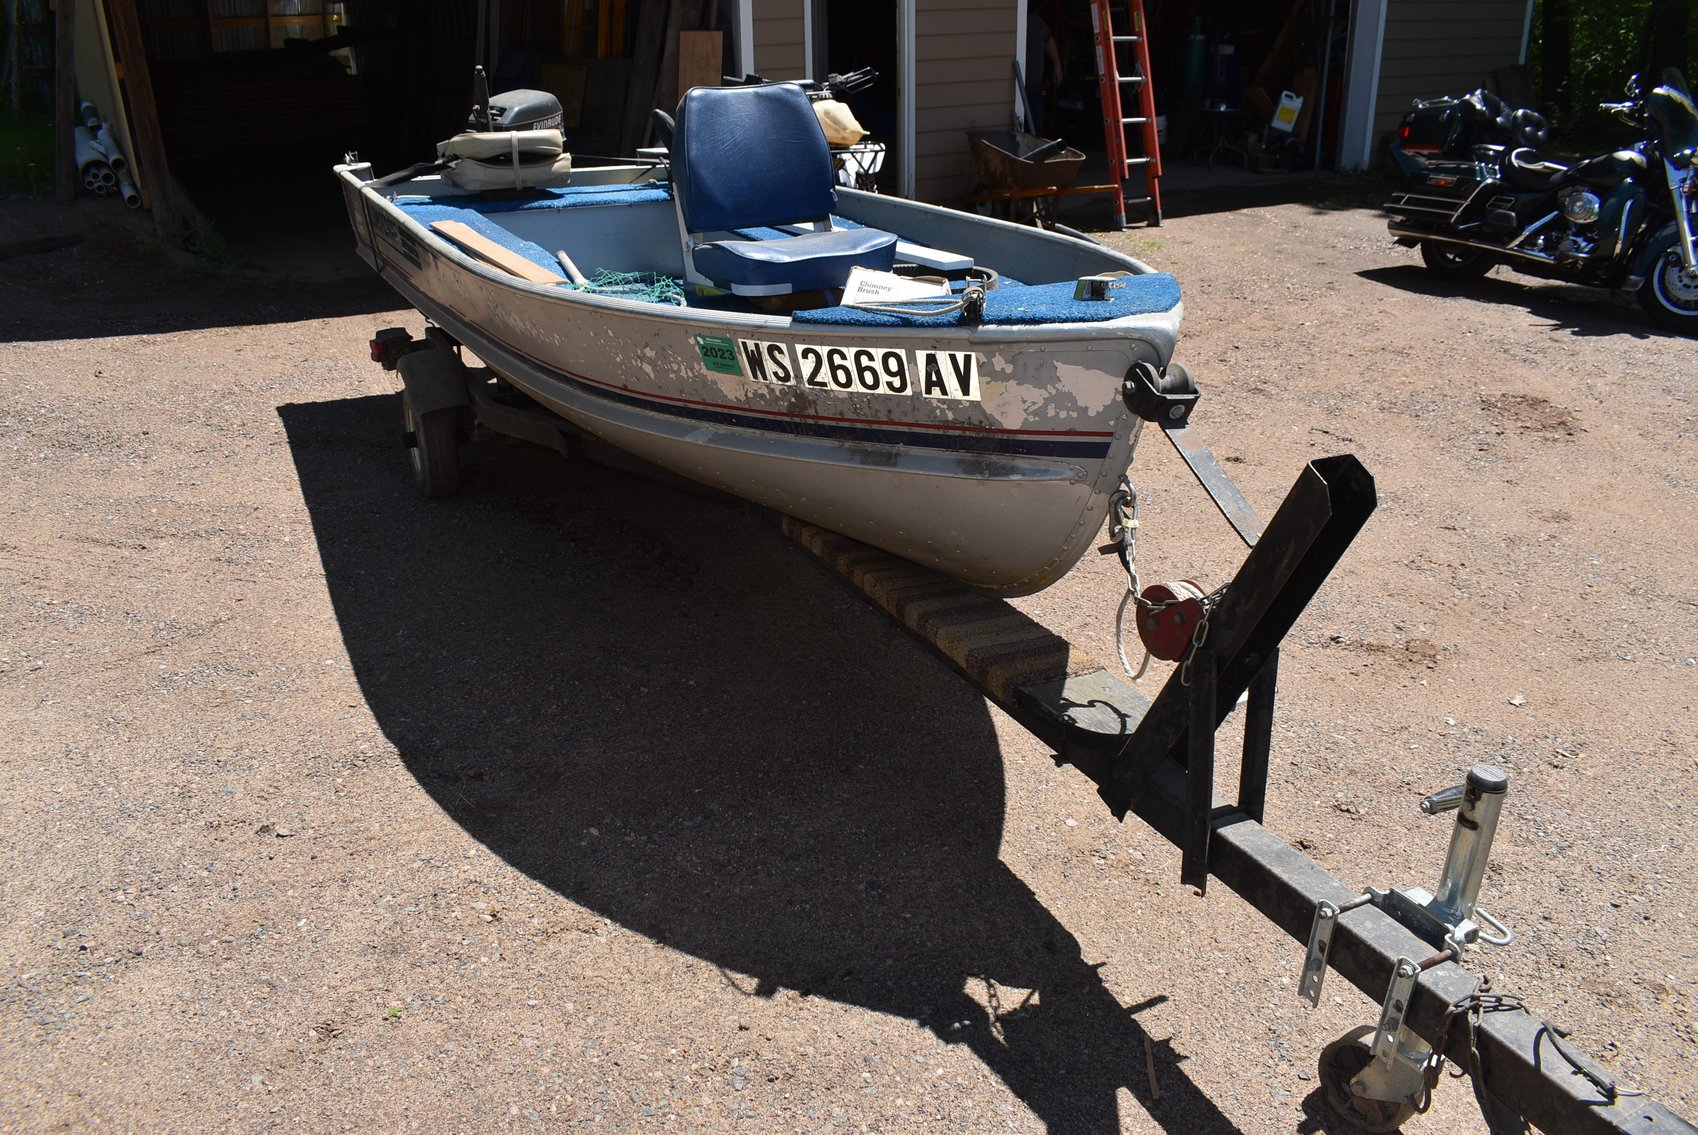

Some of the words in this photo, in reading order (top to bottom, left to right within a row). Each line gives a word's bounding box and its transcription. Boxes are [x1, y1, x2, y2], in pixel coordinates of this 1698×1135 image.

[857, 286, 880, 296] Brush
[859, 280, 892, 292] Chimney
[701, 345, 735, 361] 2023
[741, 340, 792, 383] WS
[801, 347, 908, 394] 2669
[924, 352, 973, 397] AV
